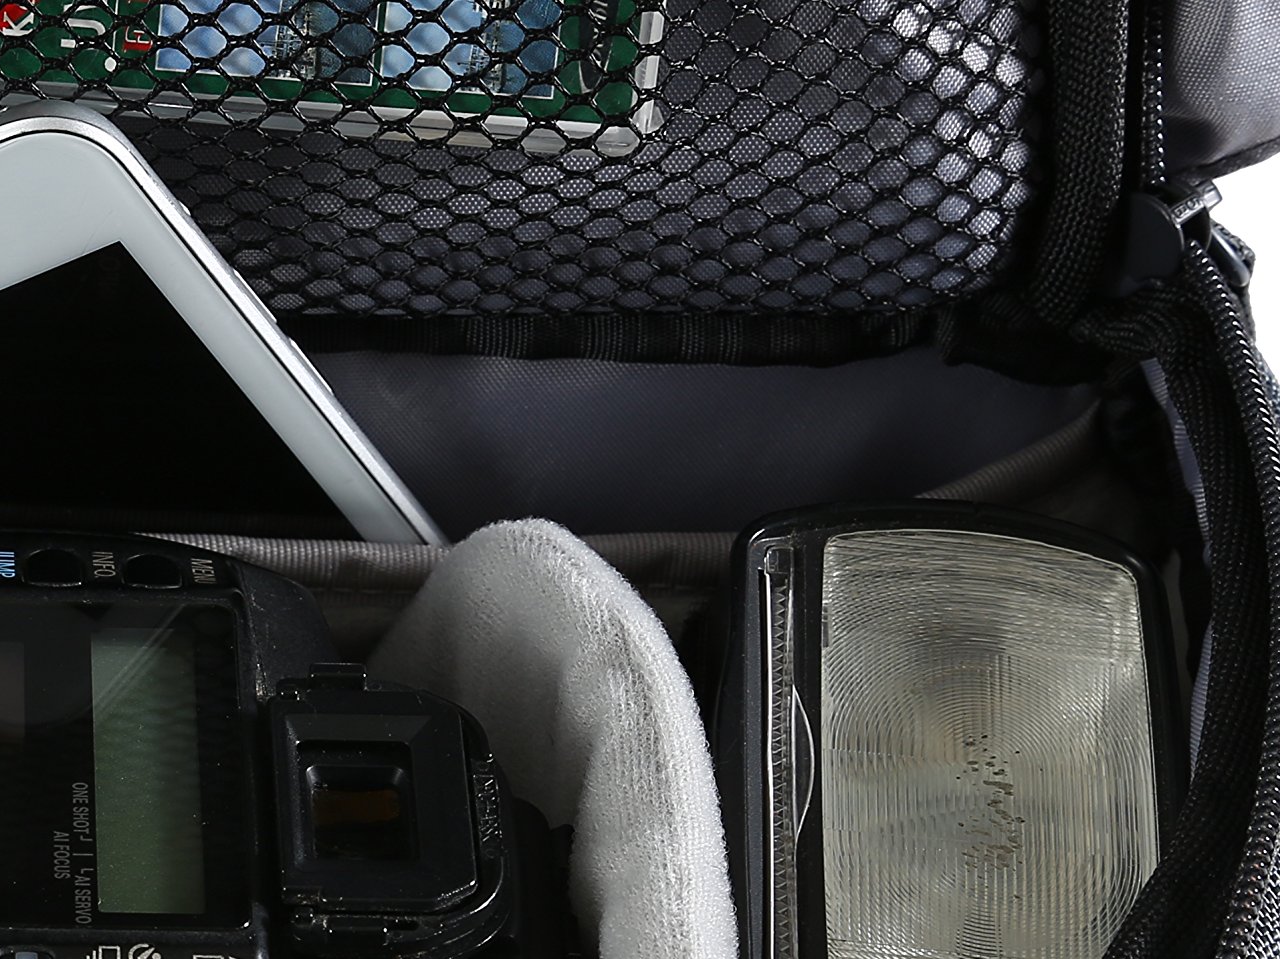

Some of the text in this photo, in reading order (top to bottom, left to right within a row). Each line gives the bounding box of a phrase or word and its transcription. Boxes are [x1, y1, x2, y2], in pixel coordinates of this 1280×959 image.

[191, 557, 218, 584] MENU
[71, 782, 89, 804] ONE
[72, 806, 90, 834] SHOT
[53, 844, 71, 879] FOCUS
[74, 889, 92, 924] SERVO
